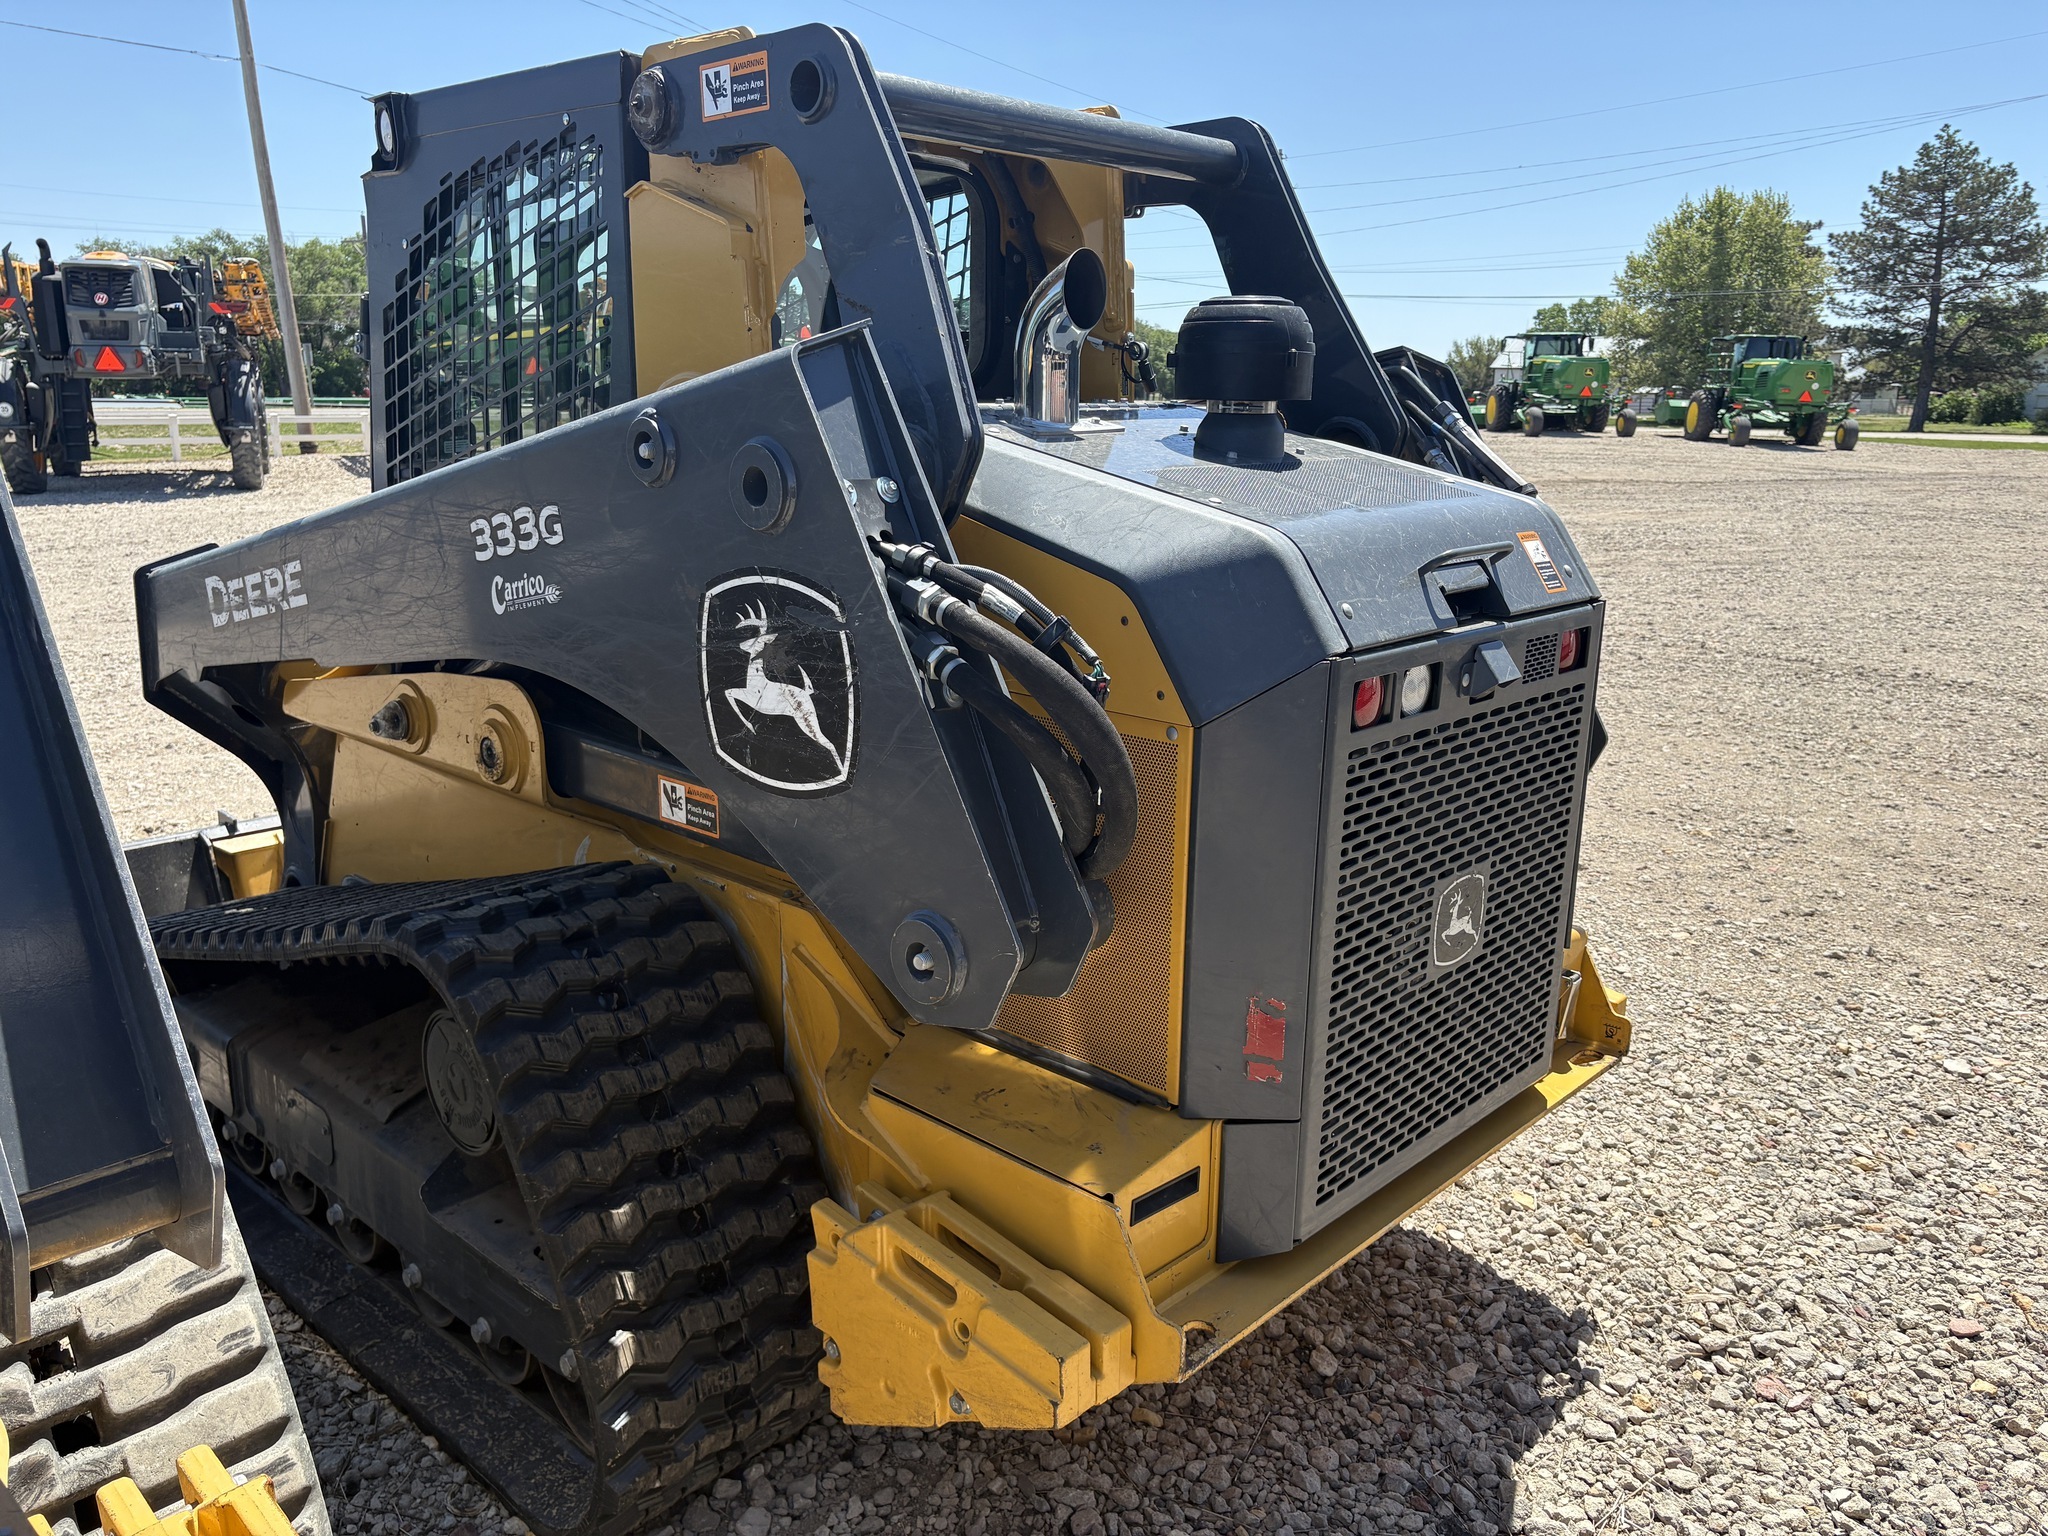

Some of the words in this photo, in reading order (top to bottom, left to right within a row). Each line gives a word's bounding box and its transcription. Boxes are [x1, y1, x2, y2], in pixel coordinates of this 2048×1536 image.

[737, 57, 764, 70] WARNING
[733, 82, 749, 92] Pinch
[750, 80, 764, 89] Area
[733, 96, 746, 104] Keep
[747, 93, 760, 101] Away
[470, 505, 564, 561] 333G
[204, 560, 309, 628] DEERE
[491, 572, 545, 615] Carrico
[687, 803, 702, 815] Pinch
[703, 809, 715, 819] Area
[687, 814, 699, 823] Keep
[700, 818, 712, 828] Away
